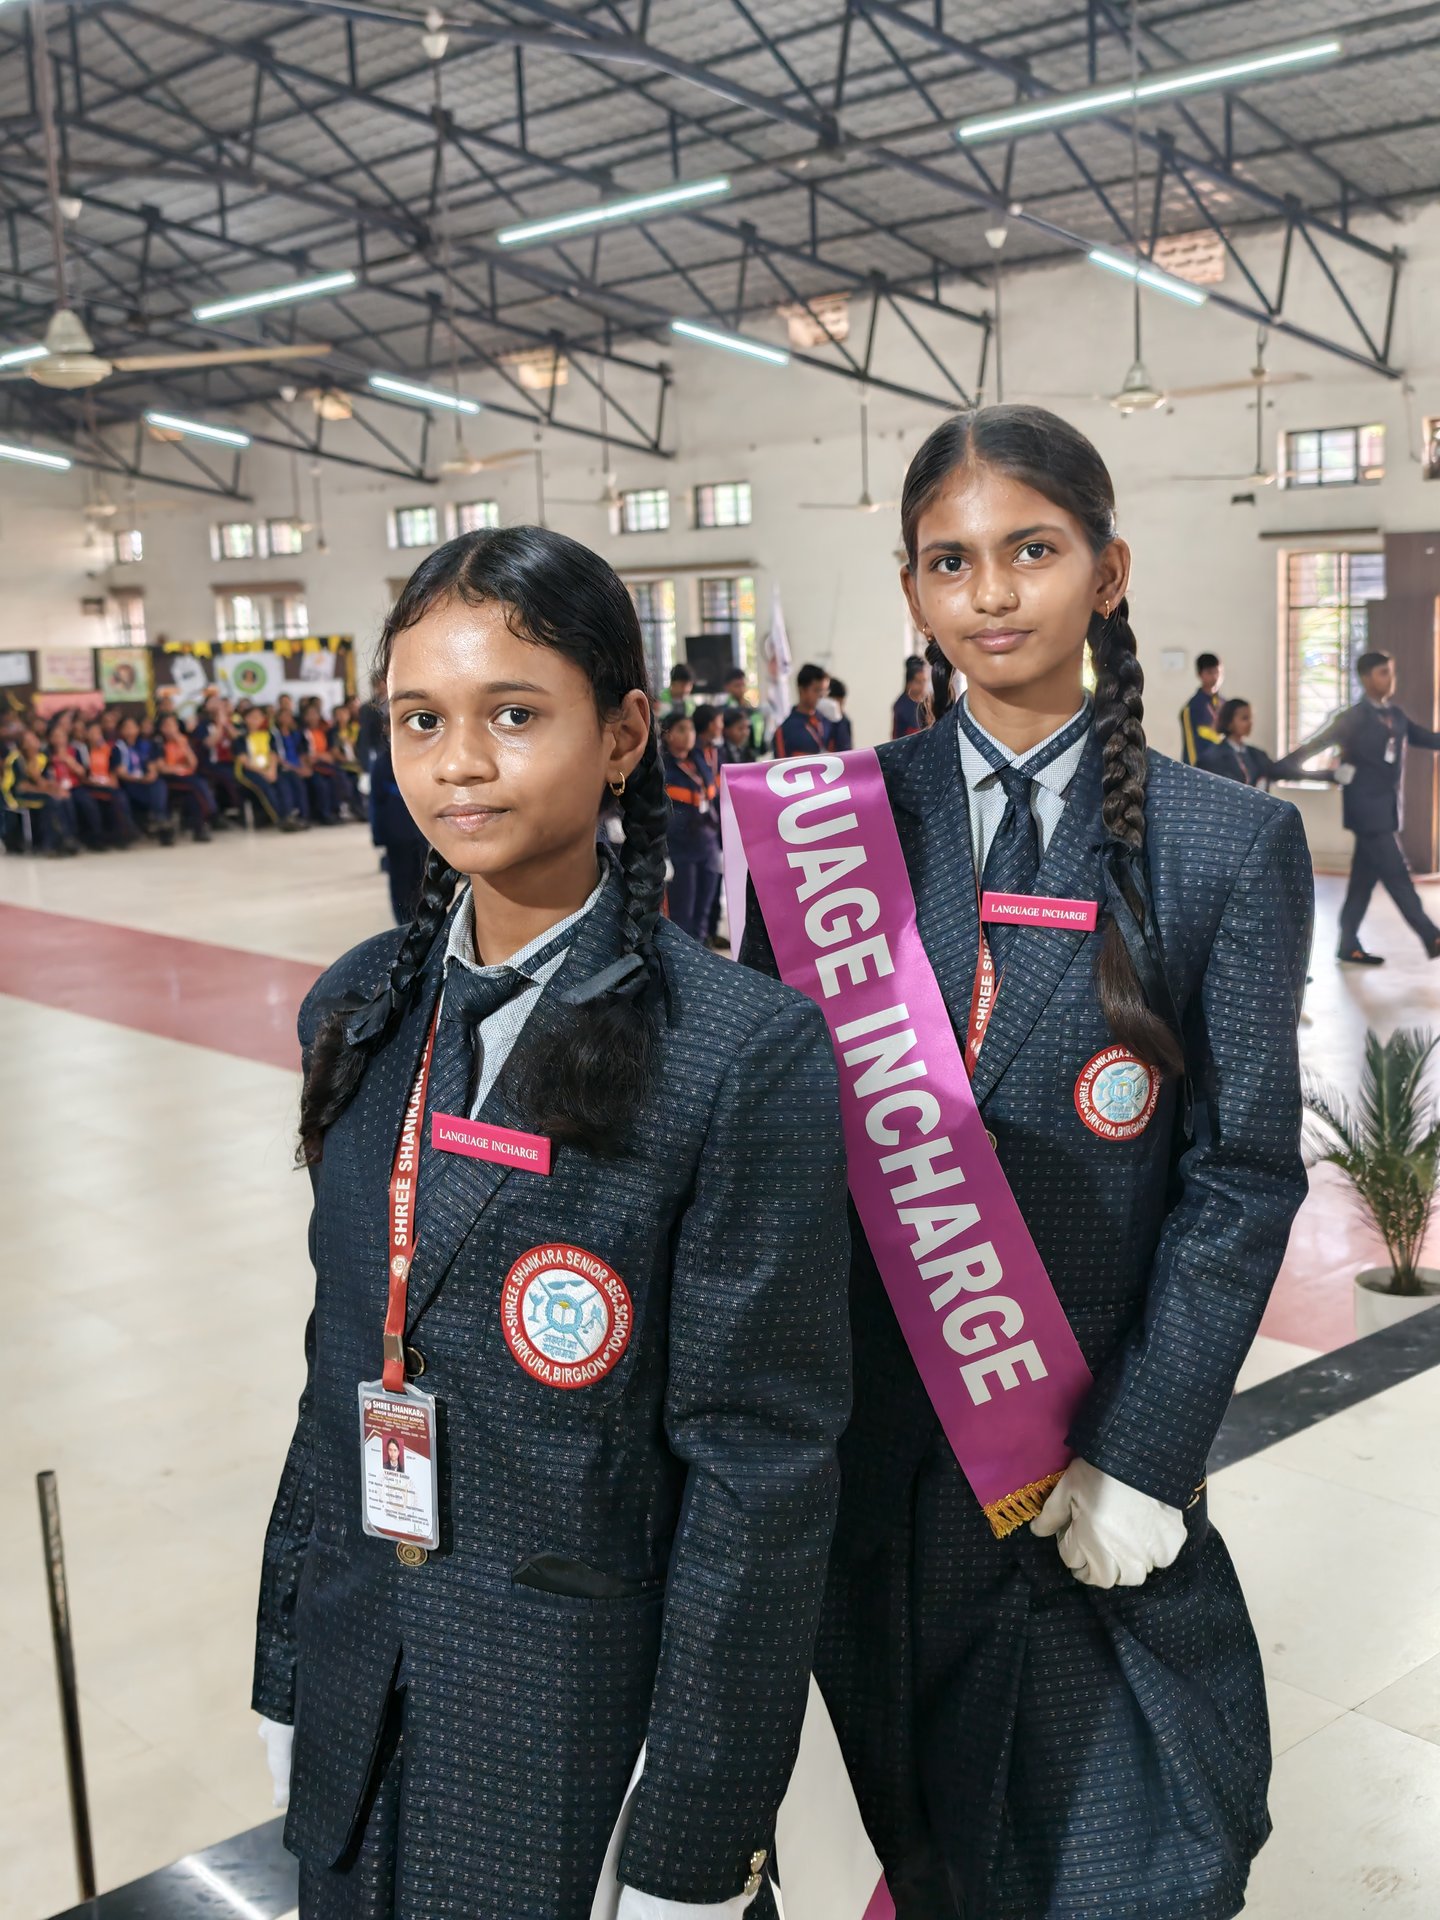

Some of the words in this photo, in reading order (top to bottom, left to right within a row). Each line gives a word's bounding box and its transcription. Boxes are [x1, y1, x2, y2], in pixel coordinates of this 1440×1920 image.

[991, 904, 1040, 917] LANGUAGE
[1042, 908, 1088, 921] INCHARGE
[976, 975, 993, 1031] SHREE
[766, 756, 894, 998] GUAGE
[835, 1002, 1049, 1407] INCHARGE
[1084, 1049, 1124, 1081] SHANKARA
[1079, 1081, 1091, 1109] SHREE
[398, 1067, 426, 1172] SHANKARA
[439, 1128, 489, 1149] LANGUAGE
[491, 1140, 539, 1161] INCHARGE
[394, 1177, 412, 1247] SHREE
[511, 1249, 564, 1286] SHANKARA
[566, 1251, 609, 1286] SENIOR
[505, 1285, 519, 1328] SHREE
[372, 1400, 391, 1411] SHREE
[391, 1404, 425, 1418] SHANKARA
